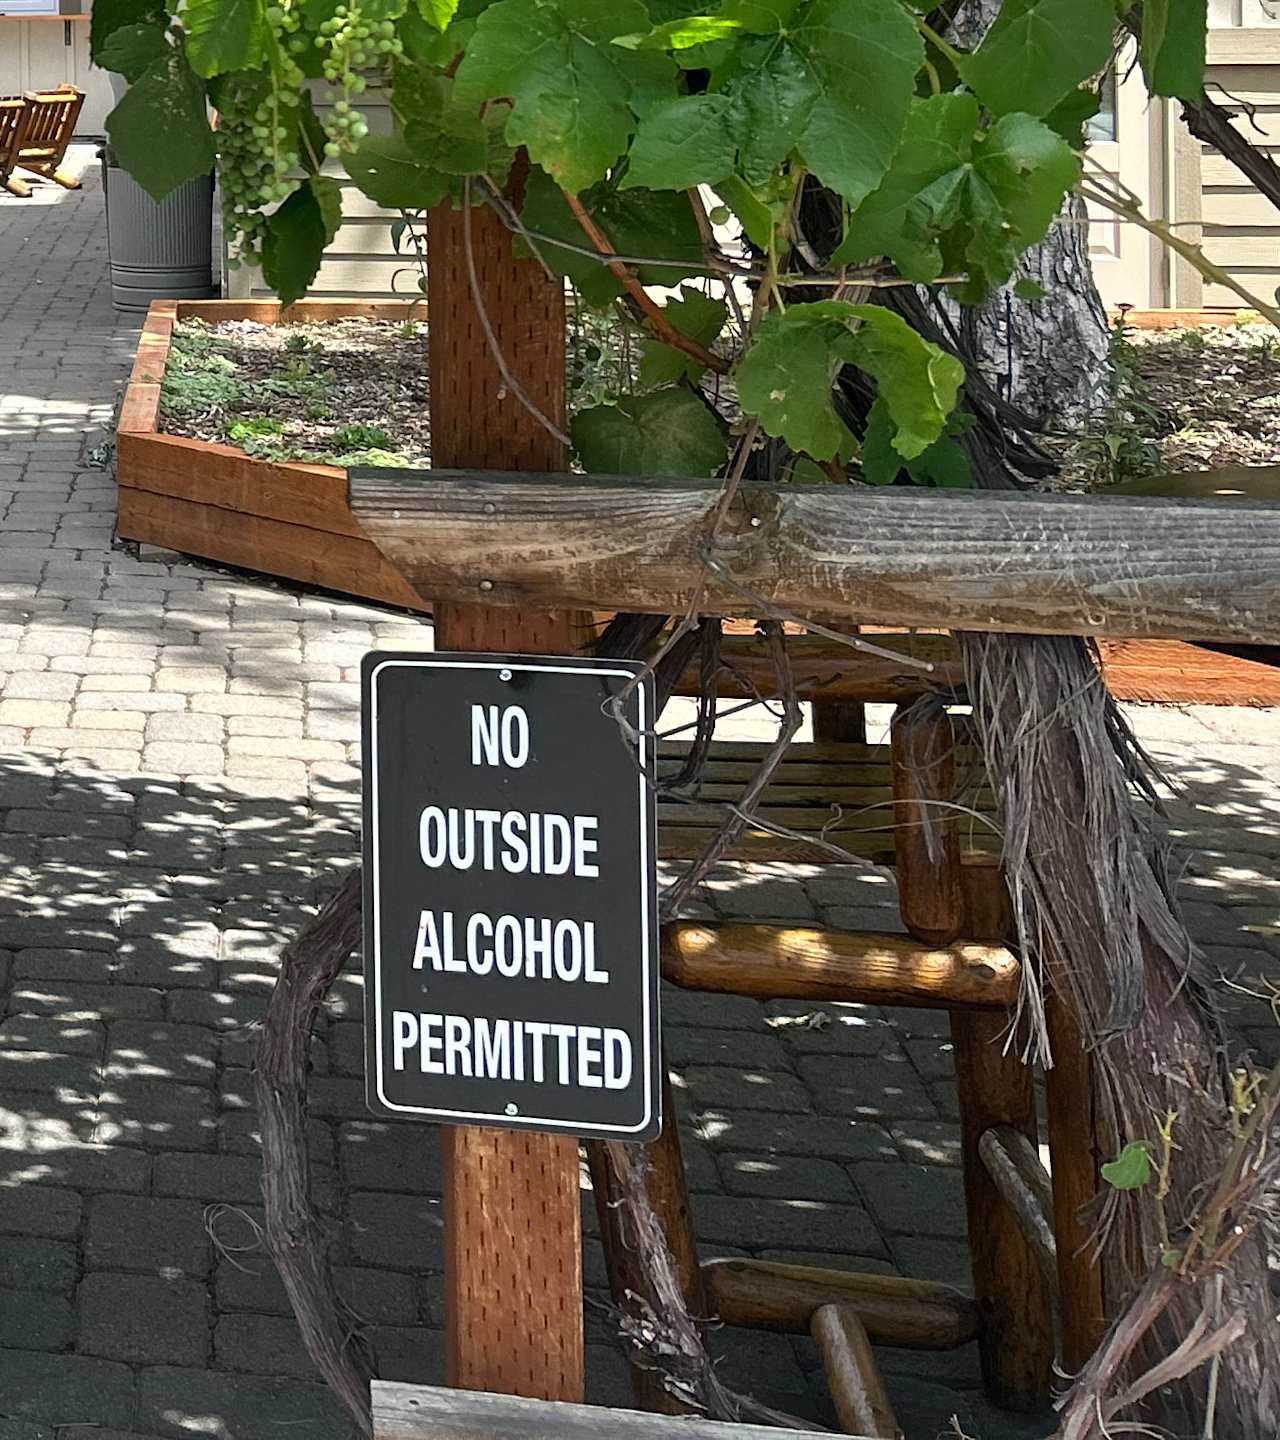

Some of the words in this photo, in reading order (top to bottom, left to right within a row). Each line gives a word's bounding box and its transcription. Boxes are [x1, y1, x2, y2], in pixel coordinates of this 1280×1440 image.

[470, 704, 530, 768] NO
[418, 805, 600, 878] OUTSIDE
[412, 910, 610, 984] ALCOHOL
[392, 1010, 633, 1090] PERMITTED
